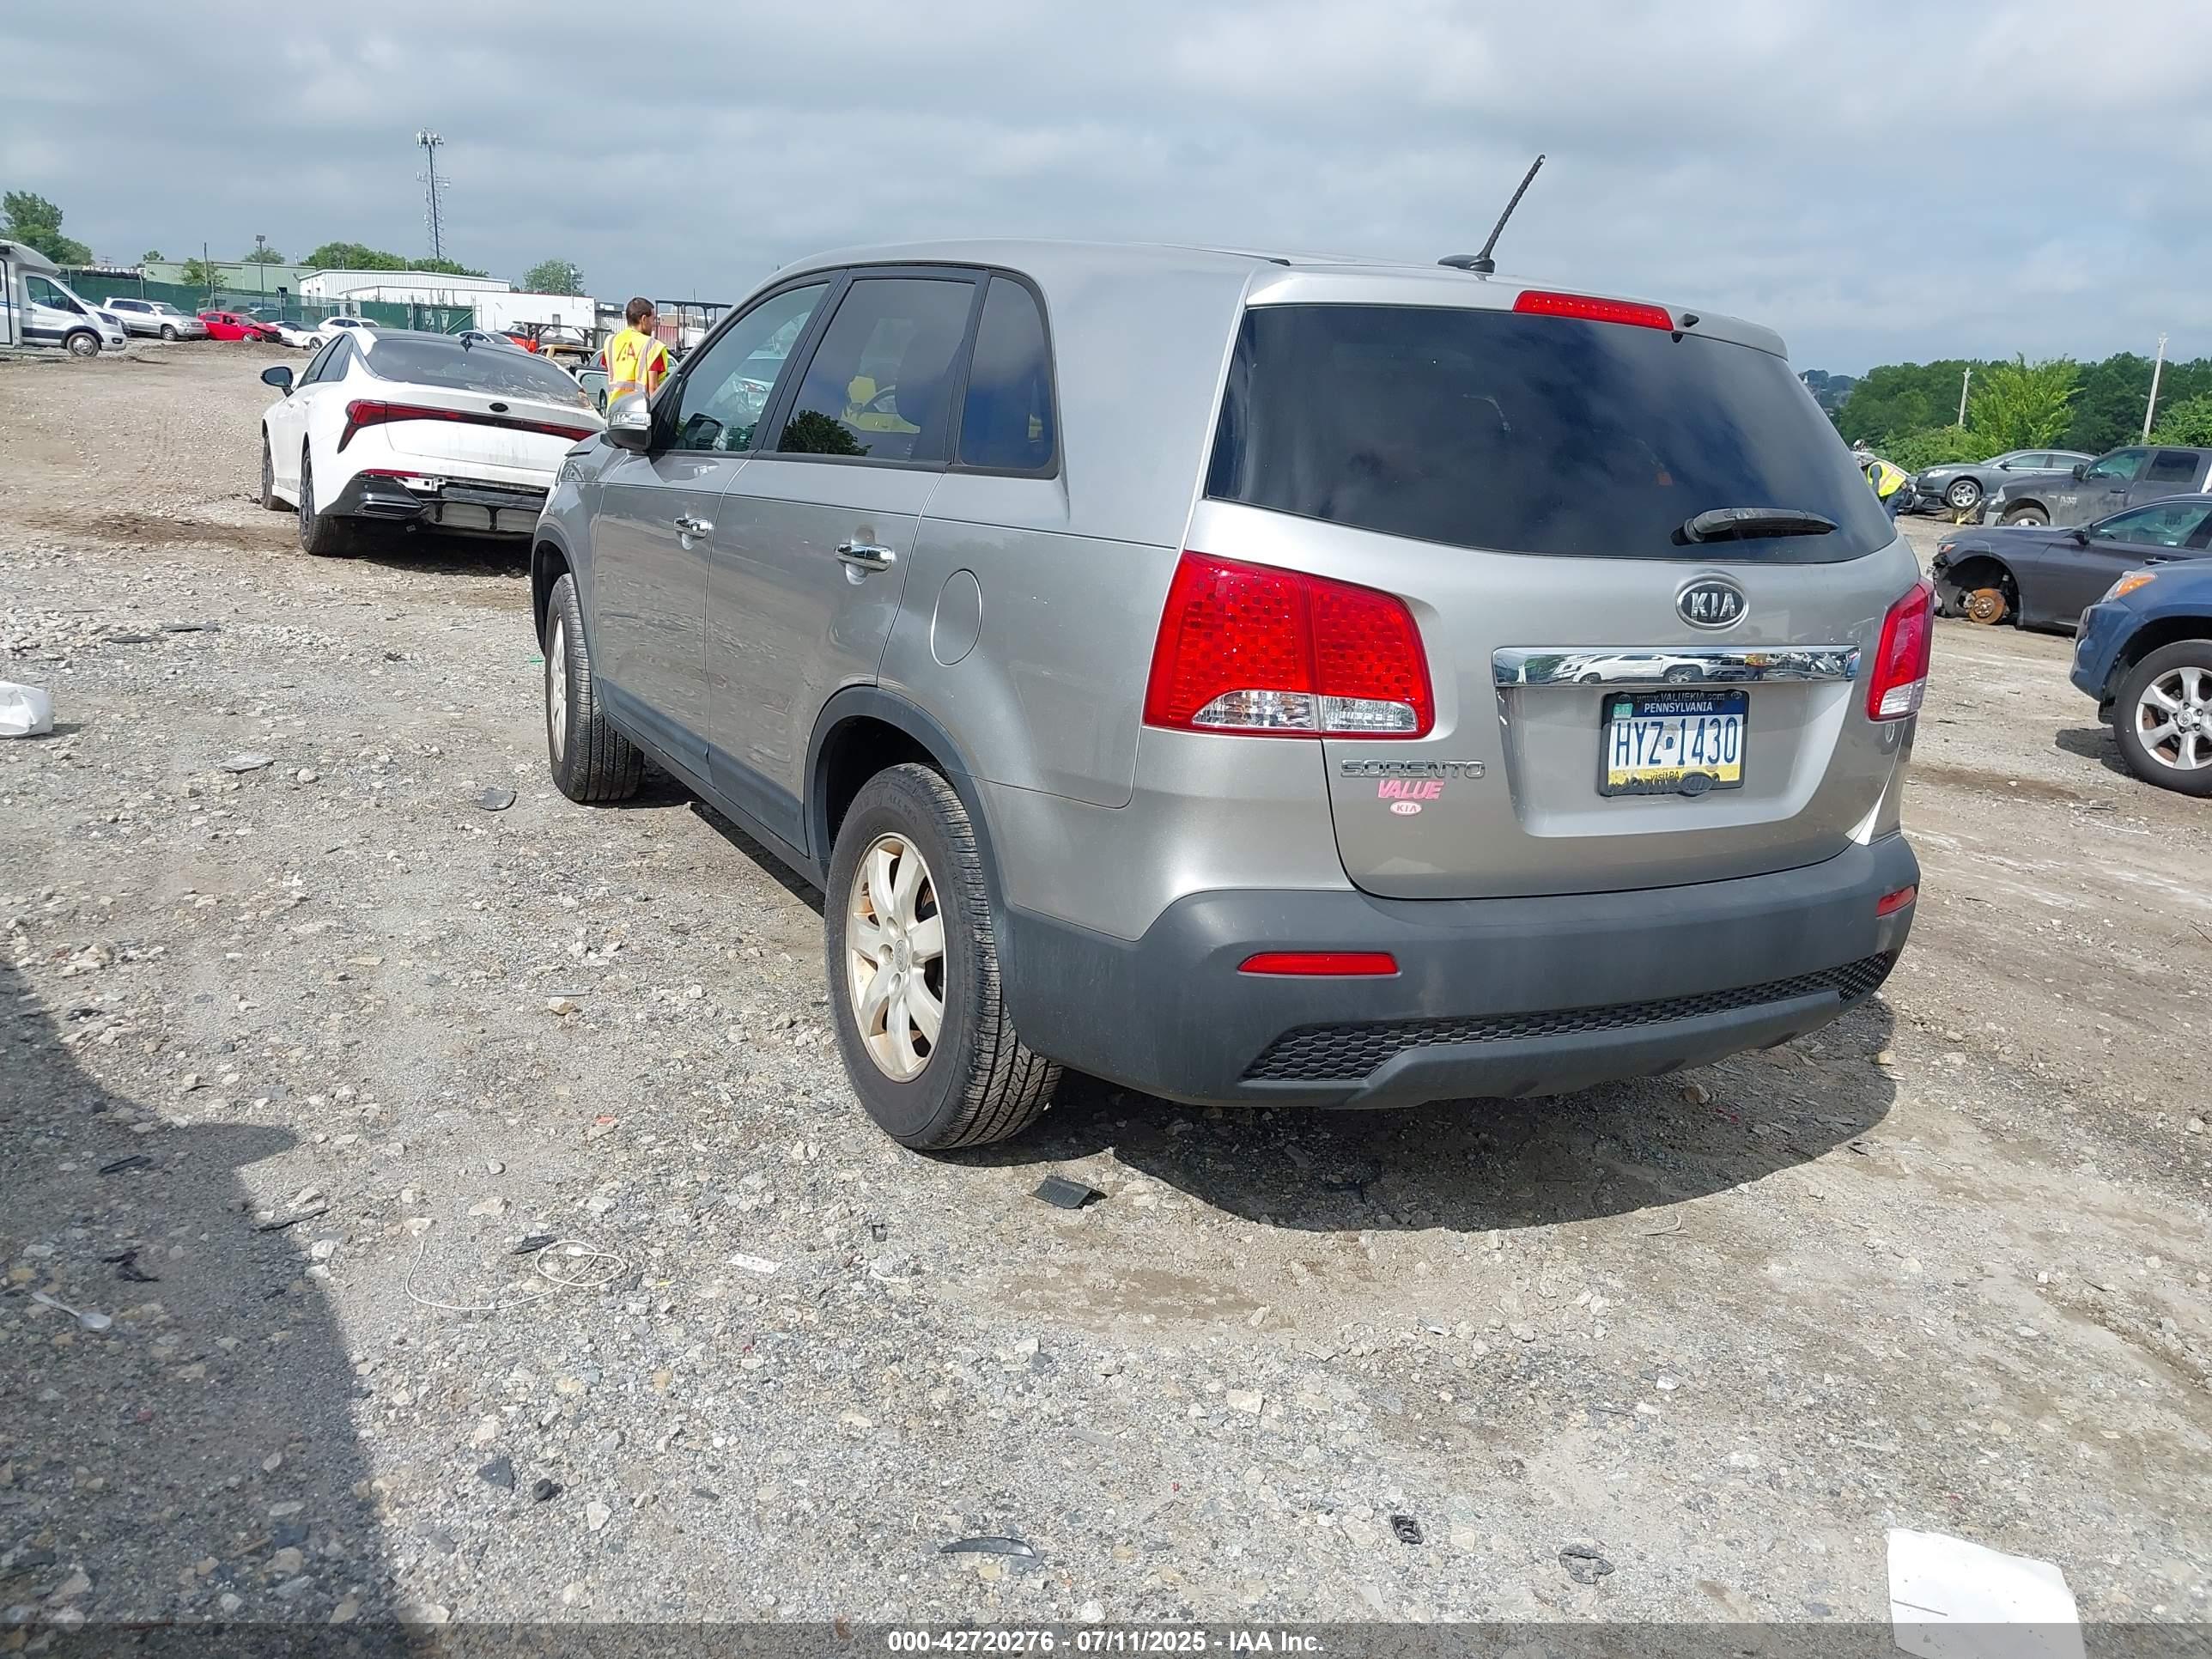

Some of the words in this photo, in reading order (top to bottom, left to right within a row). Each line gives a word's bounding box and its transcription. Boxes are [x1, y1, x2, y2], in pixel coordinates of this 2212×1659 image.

[1690, 592, 1735, 617] KIA
[1644, 702, 1714, 714] PENNSYLVANIA
[1340, 759, 1486, 778] SORENTO
[1377, 780, 1444, 799] VALUE
[1396, 804, 1417, 812] KIA
